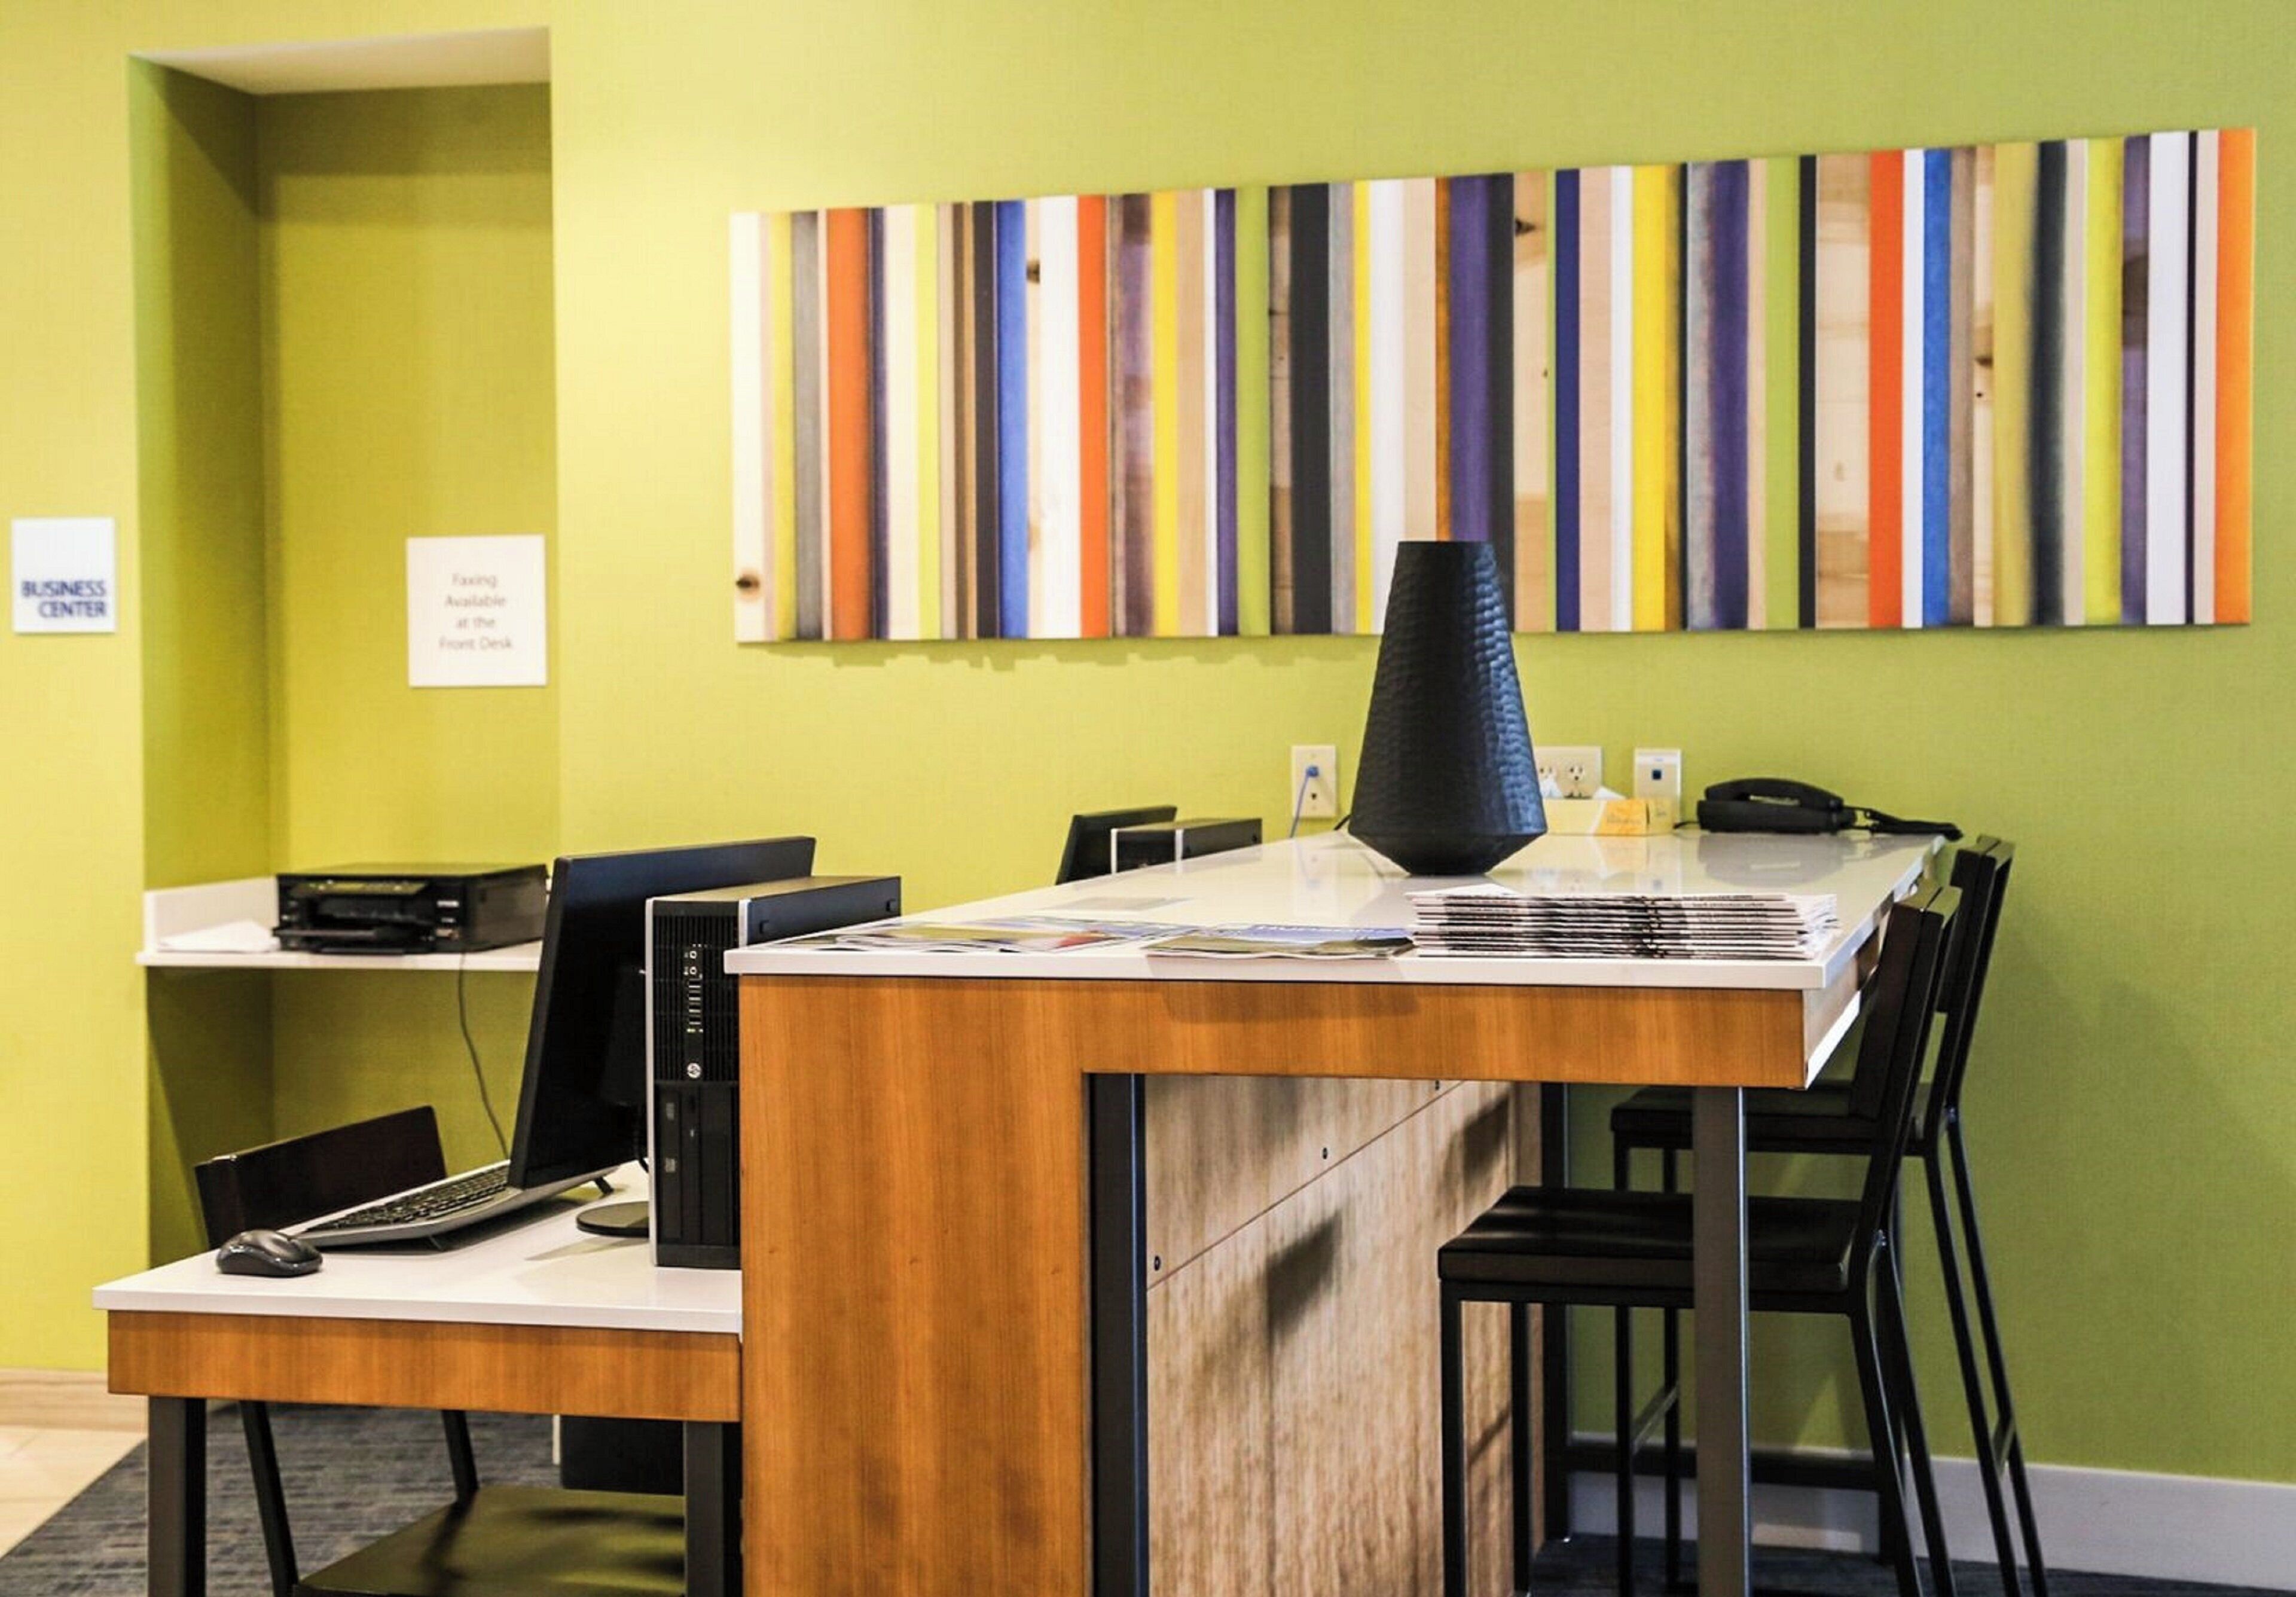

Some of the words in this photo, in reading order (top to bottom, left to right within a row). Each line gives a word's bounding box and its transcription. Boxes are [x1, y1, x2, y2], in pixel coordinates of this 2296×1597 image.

[452, 573, 497, 588] Faxing
[22, 580, 106, 597] BUSINESS
[445, 594, 507, 607] Available
[38, 601, 105, 618] CENTER
[456, 618, 468, 628] at
[473, 617, 495, 628] the
[438, 636, 475, 650] Front
[480, 637, 512, 650] Desk
